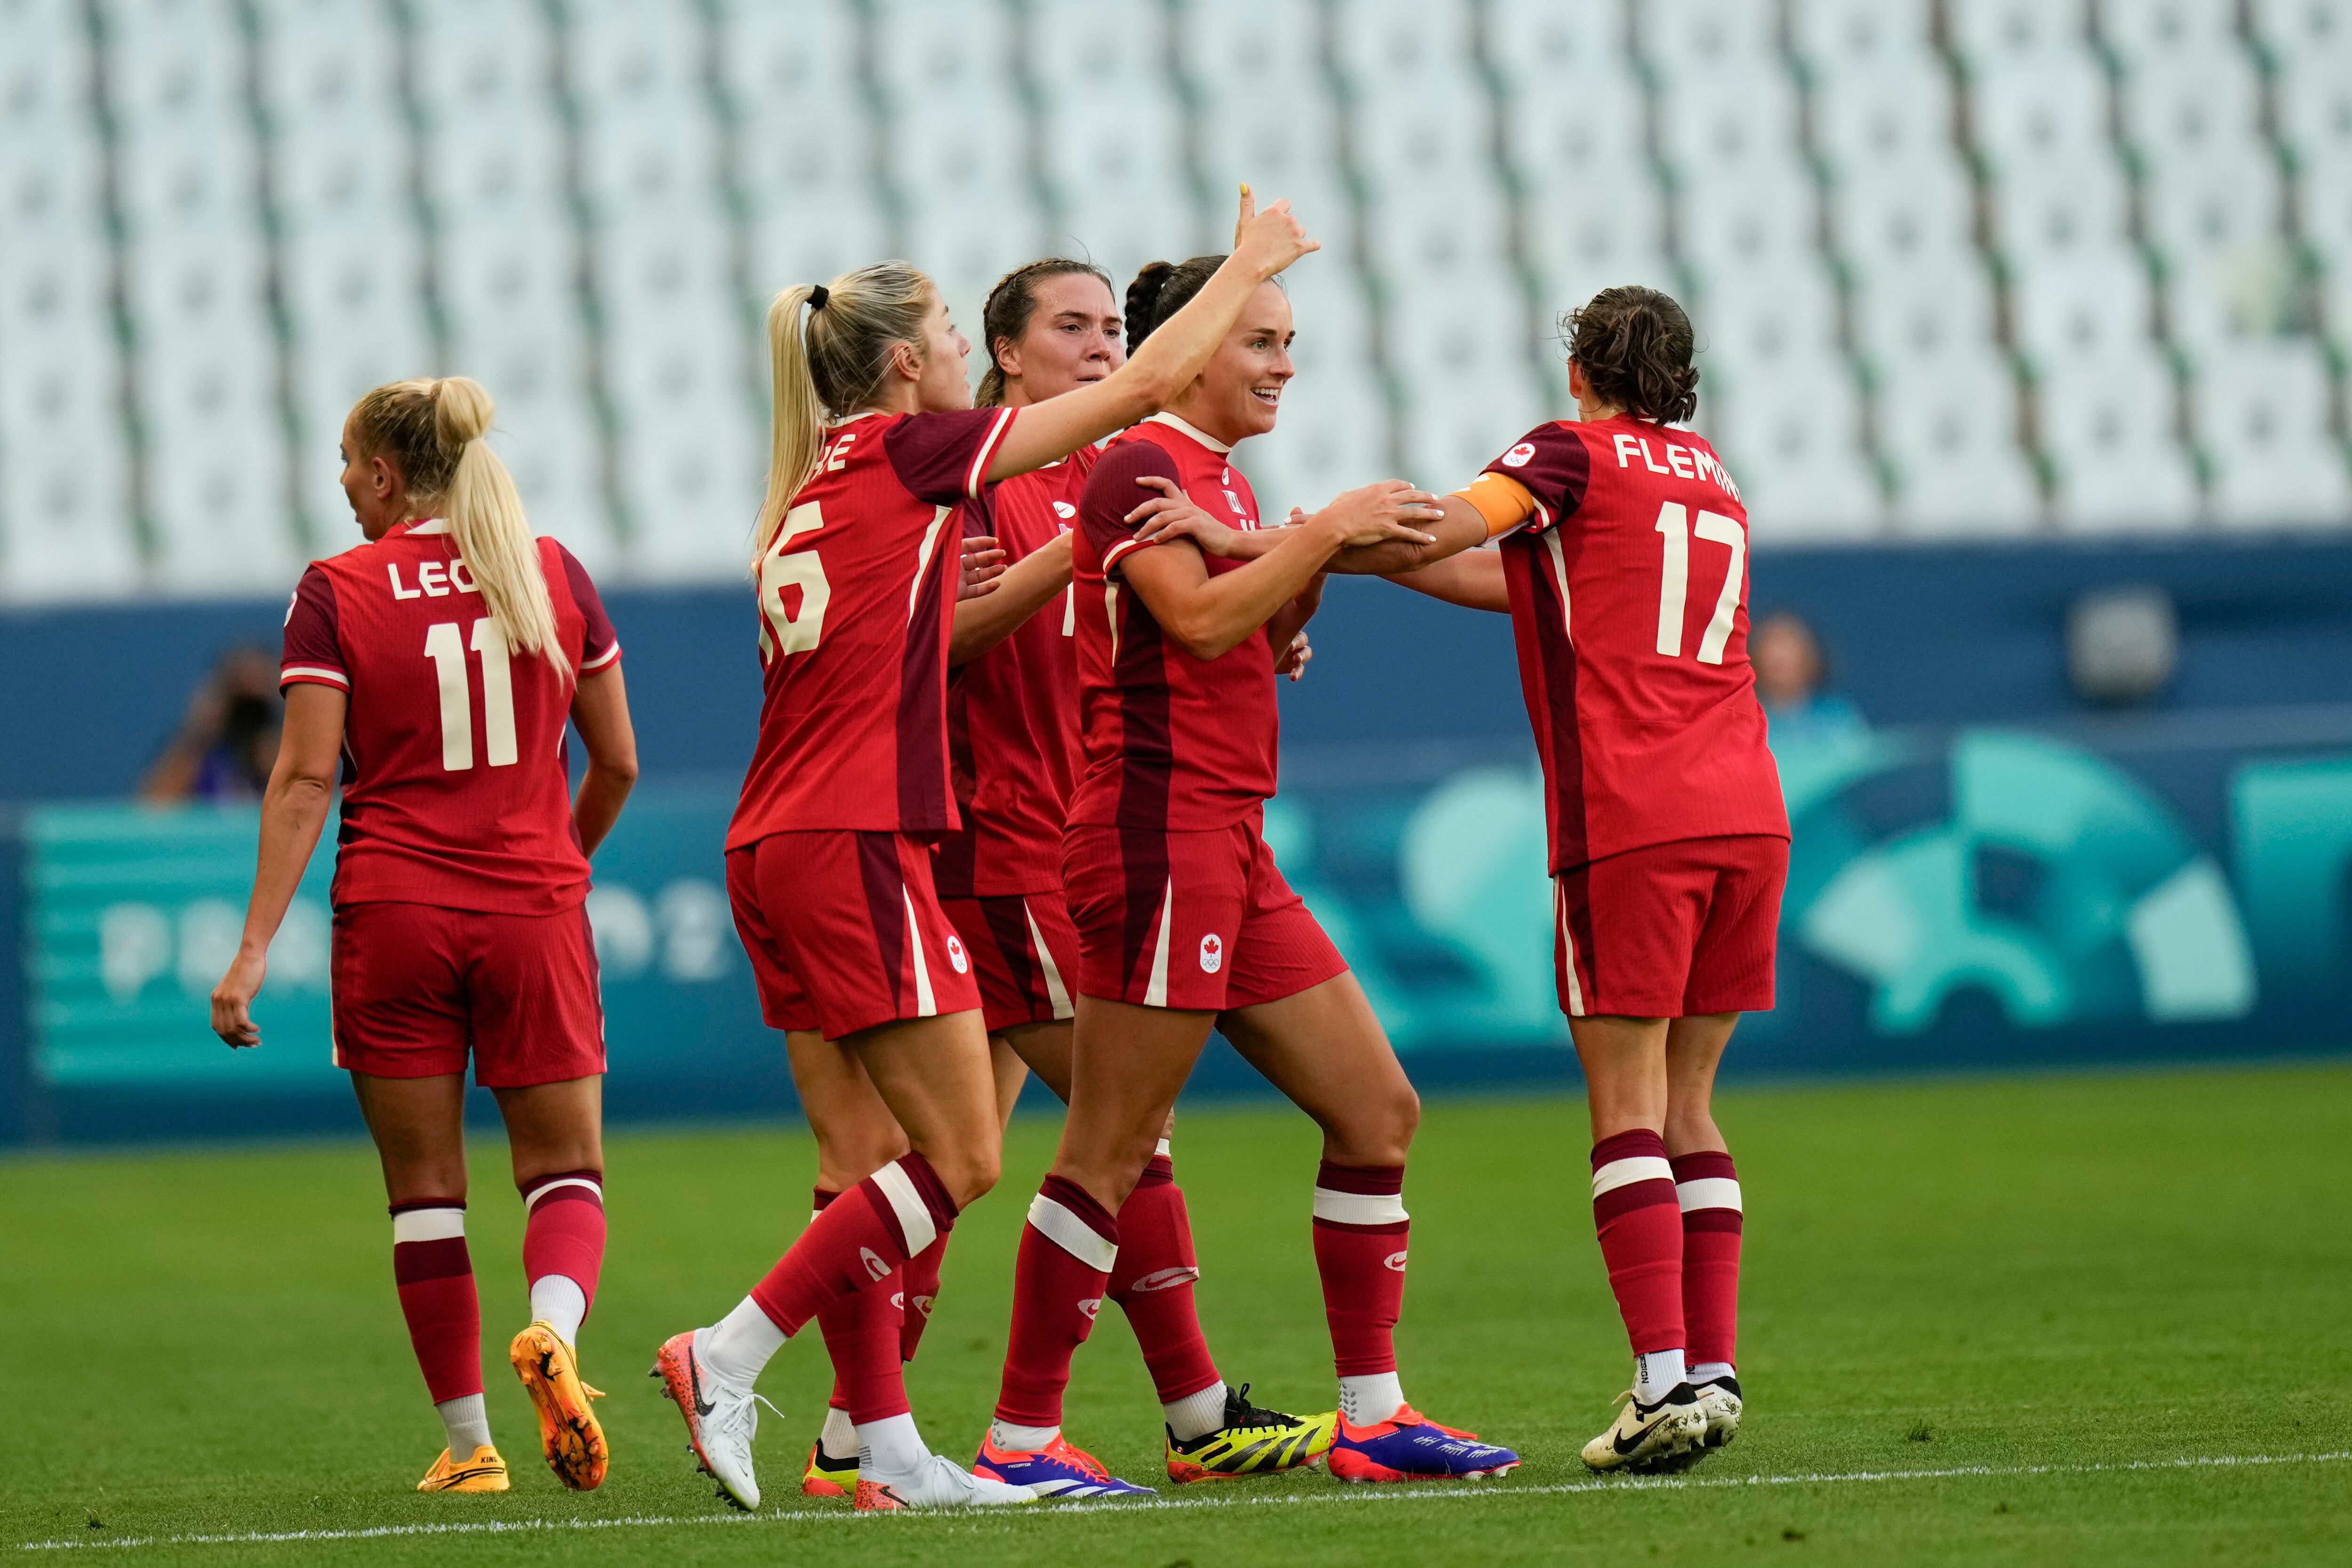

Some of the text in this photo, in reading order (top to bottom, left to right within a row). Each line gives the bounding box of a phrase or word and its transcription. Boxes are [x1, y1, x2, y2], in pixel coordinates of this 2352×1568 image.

[1613, 434, 1740, 502] FLEMIN
[388, 558, 480, 600] LEO
[1654, 501, 1746, 665] 17
[424, 617, 517, 771] 11
